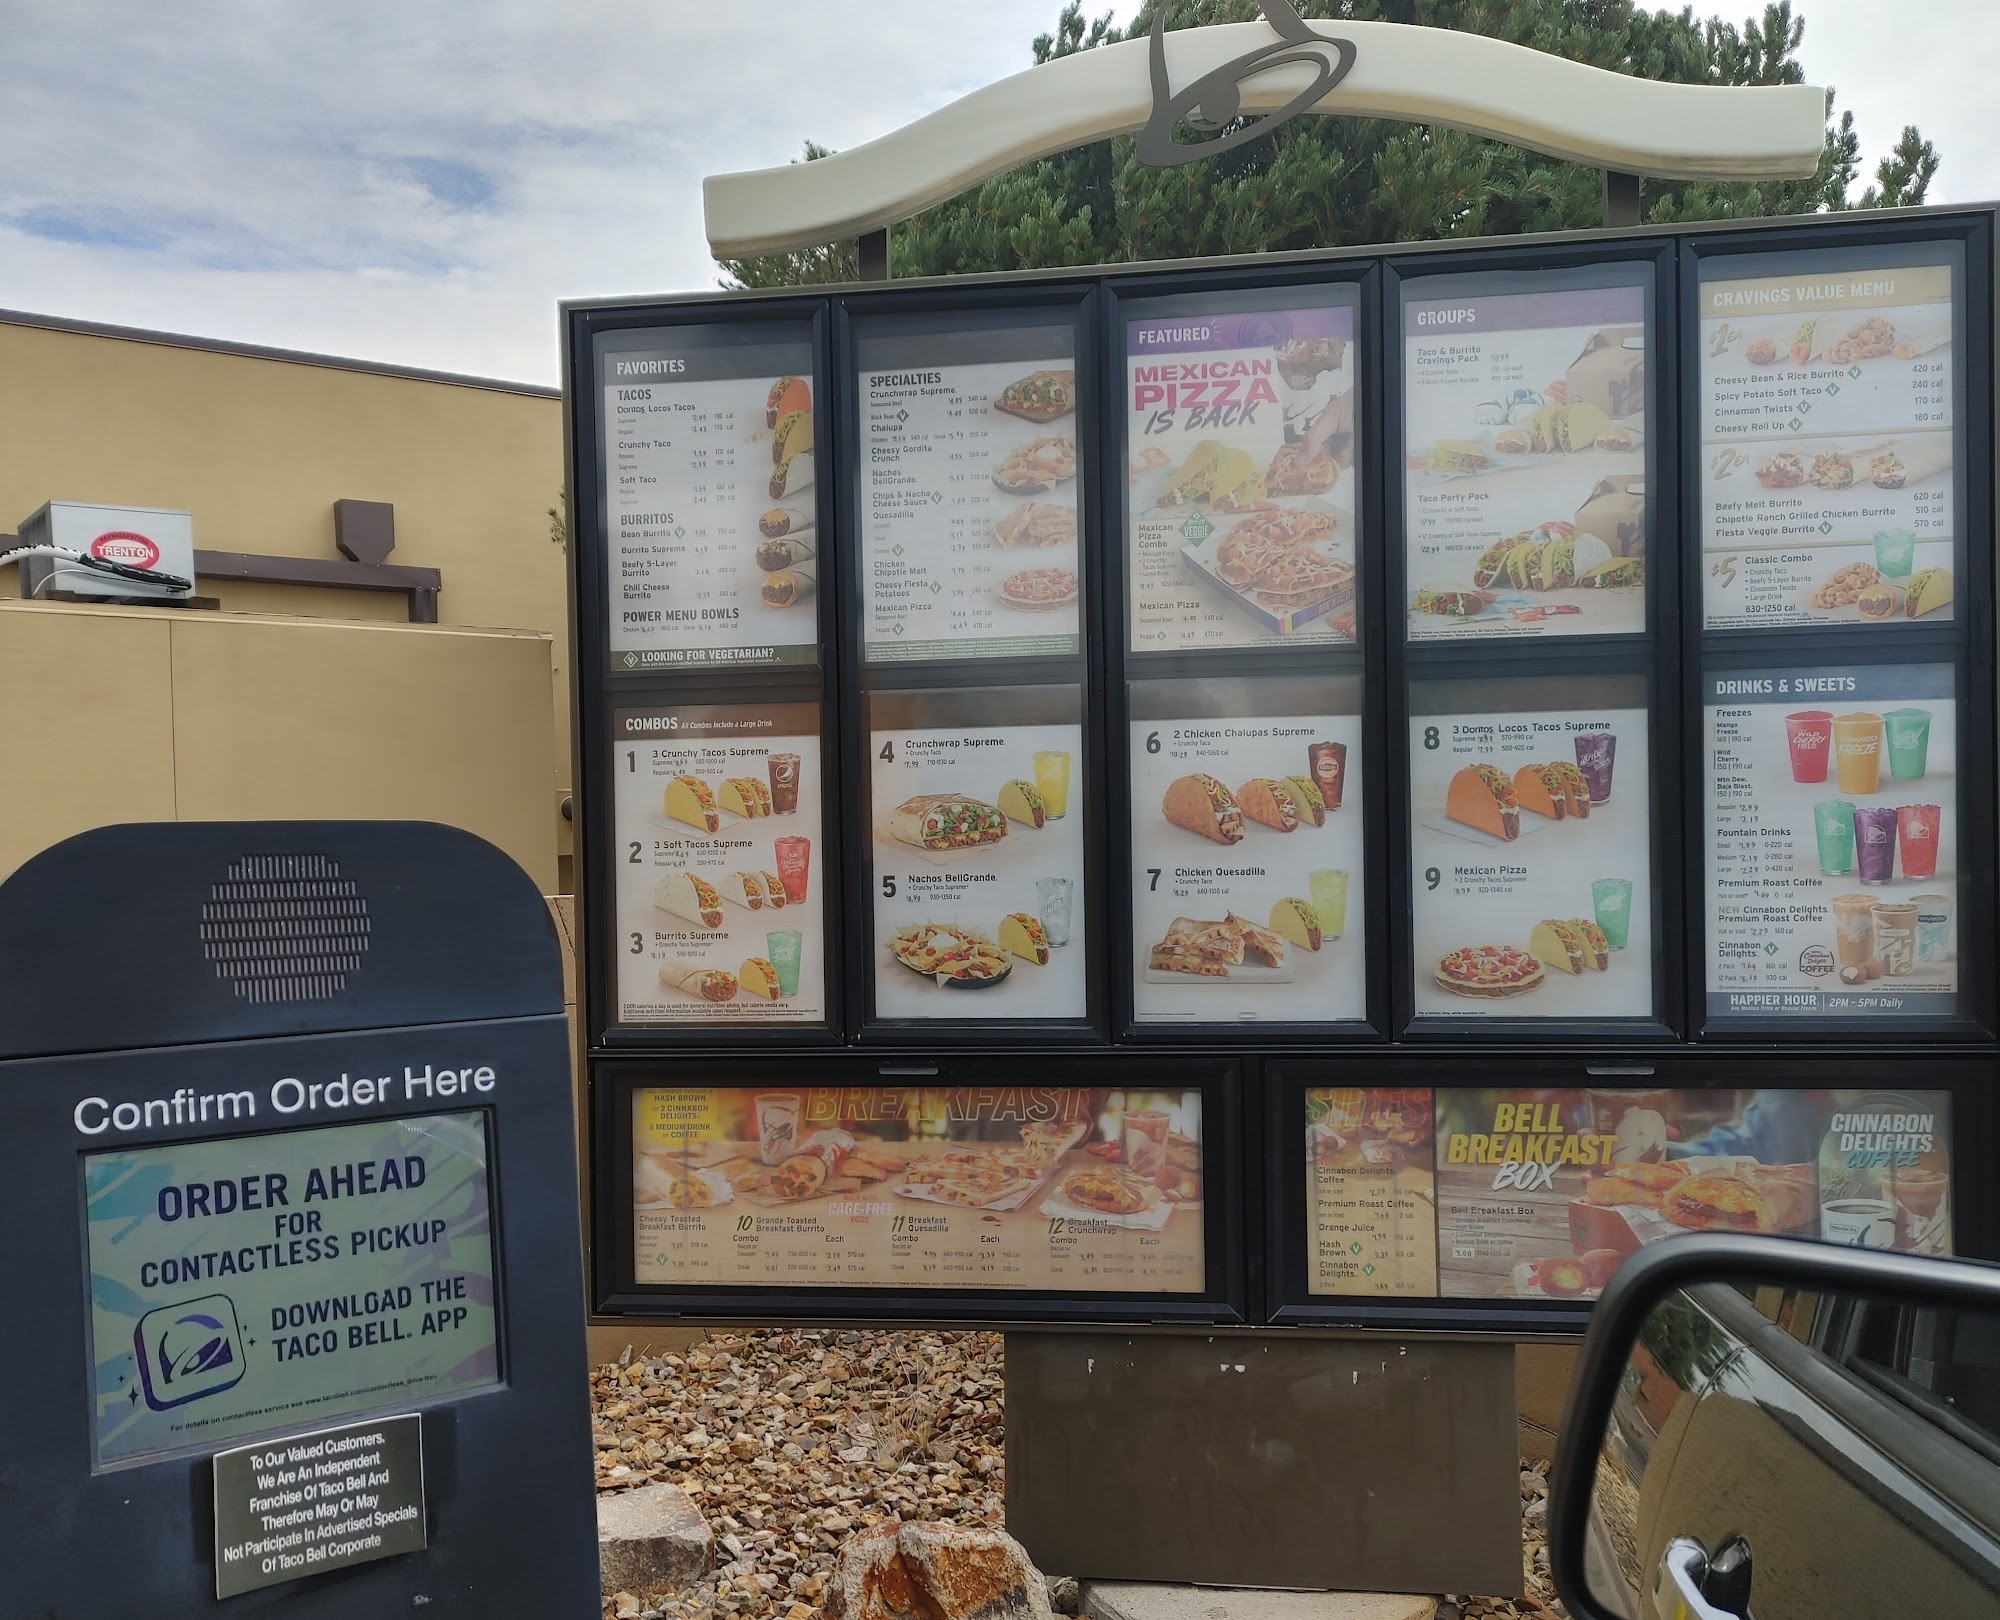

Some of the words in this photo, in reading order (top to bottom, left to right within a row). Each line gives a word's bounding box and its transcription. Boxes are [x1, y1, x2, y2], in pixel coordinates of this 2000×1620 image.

[1714, 288, 1790, 306] CRAVINGS
[1797, 285, 1845, 301] VALUE
[1851, 281, 1895, 297] MENU
[1417, 309, 1475, 325] GROUPS
[1139, 326, 1210, 344] FEATURED
[1449, 346, 1480, 354] Burrito
[617, 359, 685, 375] FAVORITES
[1417, 356, 1455, 364] Cravings
[1458, 355, 1479, 363] Pack
[1135, 358, 1272, 383] MEXICAN
[1715, 377, 1747, 385] Cheesy
[1751, 375, 1774, 383] Bean
[1788, 373, 1807, 381] Rice
[1811, 370, 1844, 379] Burrito
[1912, 364, 1928, 372] 420
[1932, 364, 1943, 372] cal
[870, 372, 941, 387] SPECIALTIES
[618, 389, 652, 401] TACOS
[1135, 378, 1278, 411] PIZZA
[1715, 392, 1739, 401] Spicy
[1743, 390, 1774, 399] Potato
[1778, 388, 1796, 397] Soft
[1801, 387, 1821, 395] Taco
[1145, 410, 1173, 434] IS
[1185, 401, 1261, 431] BACK
[1715, 408, 1761, 417] Cinnamon
[1764, 405, 1793, 413] Twists
[871, 424, 903, 433] Chalupa
[618, 440, 651, 449] Crunchy
[654, 440, 671, 448] Taco
[1418, 495, 1438, 503] Taco
[1440, 493, 1466, 503] Party
[1468, 492, 1489, 500] Pack
[1716, 502, 1742, 511] Beefy
[1746, 501, 1765, 509] Melt
[1770, 499, 1802, 507] Burrito
[621, 513, 674, 525] BURRITOS
[873, 511, 914, 519] Quesadilla
[1716, 515, 1754, 524] Chipotle
[1757, 514, 1786, 522] Ranch
[1789, 511, 1818, 520] Grilled
[1822, 510, 1858, 518] Chicken
[1862, 507, 1895, 516] Burrito
[1139, 524, 1173, 532] Mexican
[1139, 532, 1161, 540] Pizza
[1184, 526, 1209, 537] VEGGIE
[97, 546, 154, 558] TRENTON
[1139, 540, 1168, 548] Combo
[1746, 556, 1778, 564] Classic
[623, 610, 662, 622] POWER
[665, 609, 698, 621] MENU
[701, 608, 739, 620] BOWLS
[1746, 605, 1782, 613] 830-1250
[1785, 604, 1795, 612] cal
[641, 650, 684, 661] LOOKING
[687, 649, 706, 660] FOR
[708, 648, 774, 660] VEGETARIAN?
[1716, 680, 1775, 695] DRINKS
[1778, 679, 1788, 693] &
[1794, 677, 1856, 693] SWEETS
[1716, 709, 1752, 718] Freezes
[626, 717, 678, 730] COMBOS
[1174, 729, 1180, 739] 2
[1183, 729, 1221, 738] Chicken
[1224, 728, 1269, 738] Chalupas
[1272, 727, 1315, 737] Supreme
[906, 739, 960, 748] Crunchwrap
[662, 749, 698, 758] Crunchy
[730, 748, 769, 756] Supreme
[879, 741, 894, 764] 4
[627, 751, 635, 772] 1
[1717, 829, 1757, 837] Fountain
[1761, 828, 1791, 836] Drinks
[1175, 868, 1213, 876] Chicken
[1216, 866, 1265, 877] Quesadilla
[1425, 867, 1441, 890] 9
[1455, 866, 1496, 875] Mexican
[1500, 866, 1527, 874] Pizza
[1147, 868, 1162, 891] 7
[1730, 995, 1780, 1005] HAPPIER
[1784, 994, 1817, 1005] HOUR
[1830, 998, 1848, 1007] 2PM
[1858, 998, 1877, 1007] 5PM
[1880, 998, 1903, 1009] Daily
[74, 1089, 255, 1135] Confirm
[270, 1074, 390, 1113] Order
[404, 1065, 496, 1100] Here
[806, 1088, 1090, 1121] BREAKFAST
[1494, 1103, 1564, 1133] BELL
[1832, 1114, 1934, 1133] CINNABON
[1447, 1134, 1619, 1165] BREAKFAST
[1840, 1133, 1933, 1152] DELIGHTS
[1845, 1151, 1922, 1168] COFFEE
[1492, 1160, 1561, 1191] BOX
[158, 1173, 288, 1222] ORDER
[304, 1156, 426, 1203] AHEAD
[828, 1202, 894, 1215] CAGE-FREE
[275, 1211, 322, 1238] FOR
[737, 1215, 752, 1232] 10
[141, 1237, 339, 1288] CONTACTLESS
[352, 1220, 447, 1256] PICKUP
[271, 1287, 412, 1331] DOWNLOAD
[421, 1278, 466, 1306] THE
[272, 1331, 338, 1362] TACO
[421, 1308, 468, 1336] APP
[250, 1456, 263, 1470] To
[265, 1453, 285, 1467] Our
[287, 1442, 323, 1464] Valued
[257, 1475, 274, 1490] We
[277, 1470, 295, 1485] Are
[298, 1467, 312, 1481] An
[315, 1451, 380, 1479] Independent
[250, 1488, 302, 1513] Franchise
[304, 1485, 317, 1499] Of
[319, 1481, 344, 1498] Taco
[347, 1474, 365, 1490] Bell
[368, 1469, 389, 1487] And
[262, 1510, 314, 1531] Therefore
[316, 1503, 339, 1520] May
[340, 1498, 354, 1512] Or
[356, 1494, 378, 1511] May
[224, 1547, 243, 1562] Not
[245, 1532, 302, 1556] Participate
[304, 1528, 315, 1542] In
[317, 1516, 372, 1539] Advertised
[374, 1504, 417, 1525] Specials
[262, 1558, 276, 1573] Of
[278, 1553, 304, 1570] Taco
[306, 1547, 326, 1563] Bell
[328, 1533, 381, 1557] Corporate
